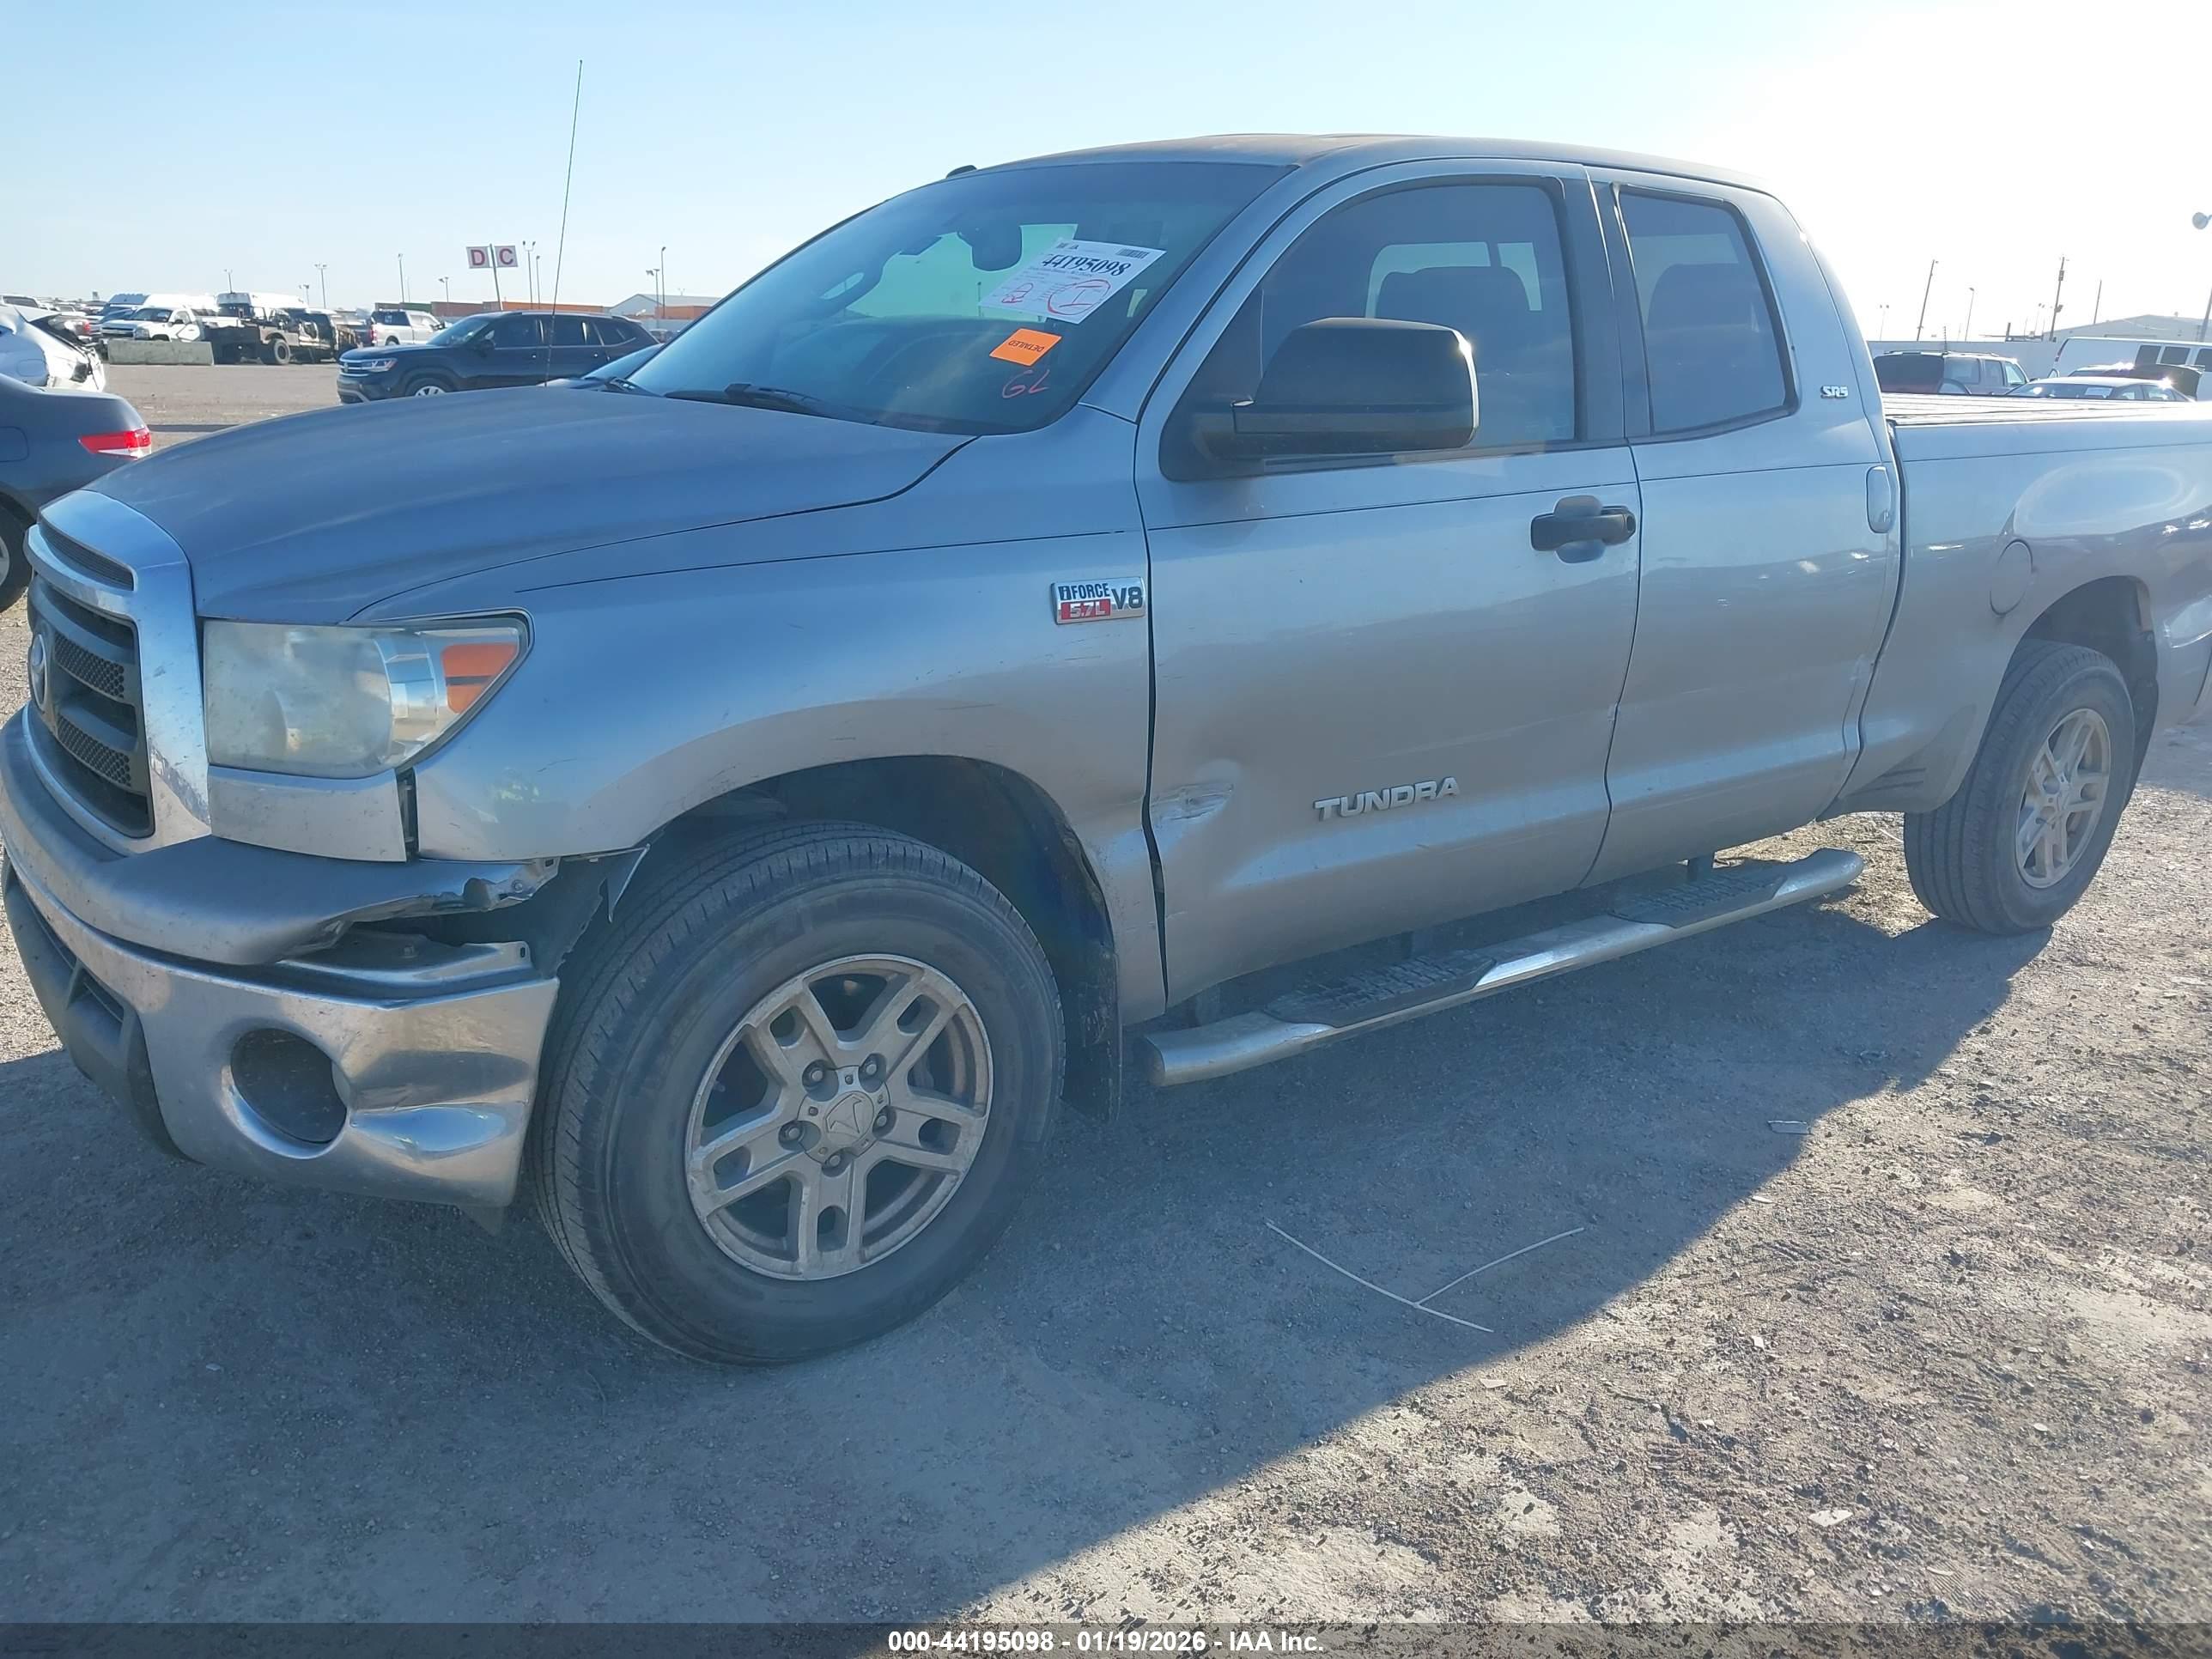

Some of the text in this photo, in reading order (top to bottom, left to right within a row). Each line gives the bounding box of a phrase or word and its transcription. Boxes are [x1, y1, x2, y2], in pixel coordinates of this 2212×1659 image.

[471, 248, 514, 266] D C
[1042, 254, 1132, 276] 44195098
[1008, 339, 1045, 352] DETAILED
[1111, 586, 1144, 611] V8
[1069, 600, 1106, 618] 5.7L
[1314, 776, 1461, 821] TUNDRA
